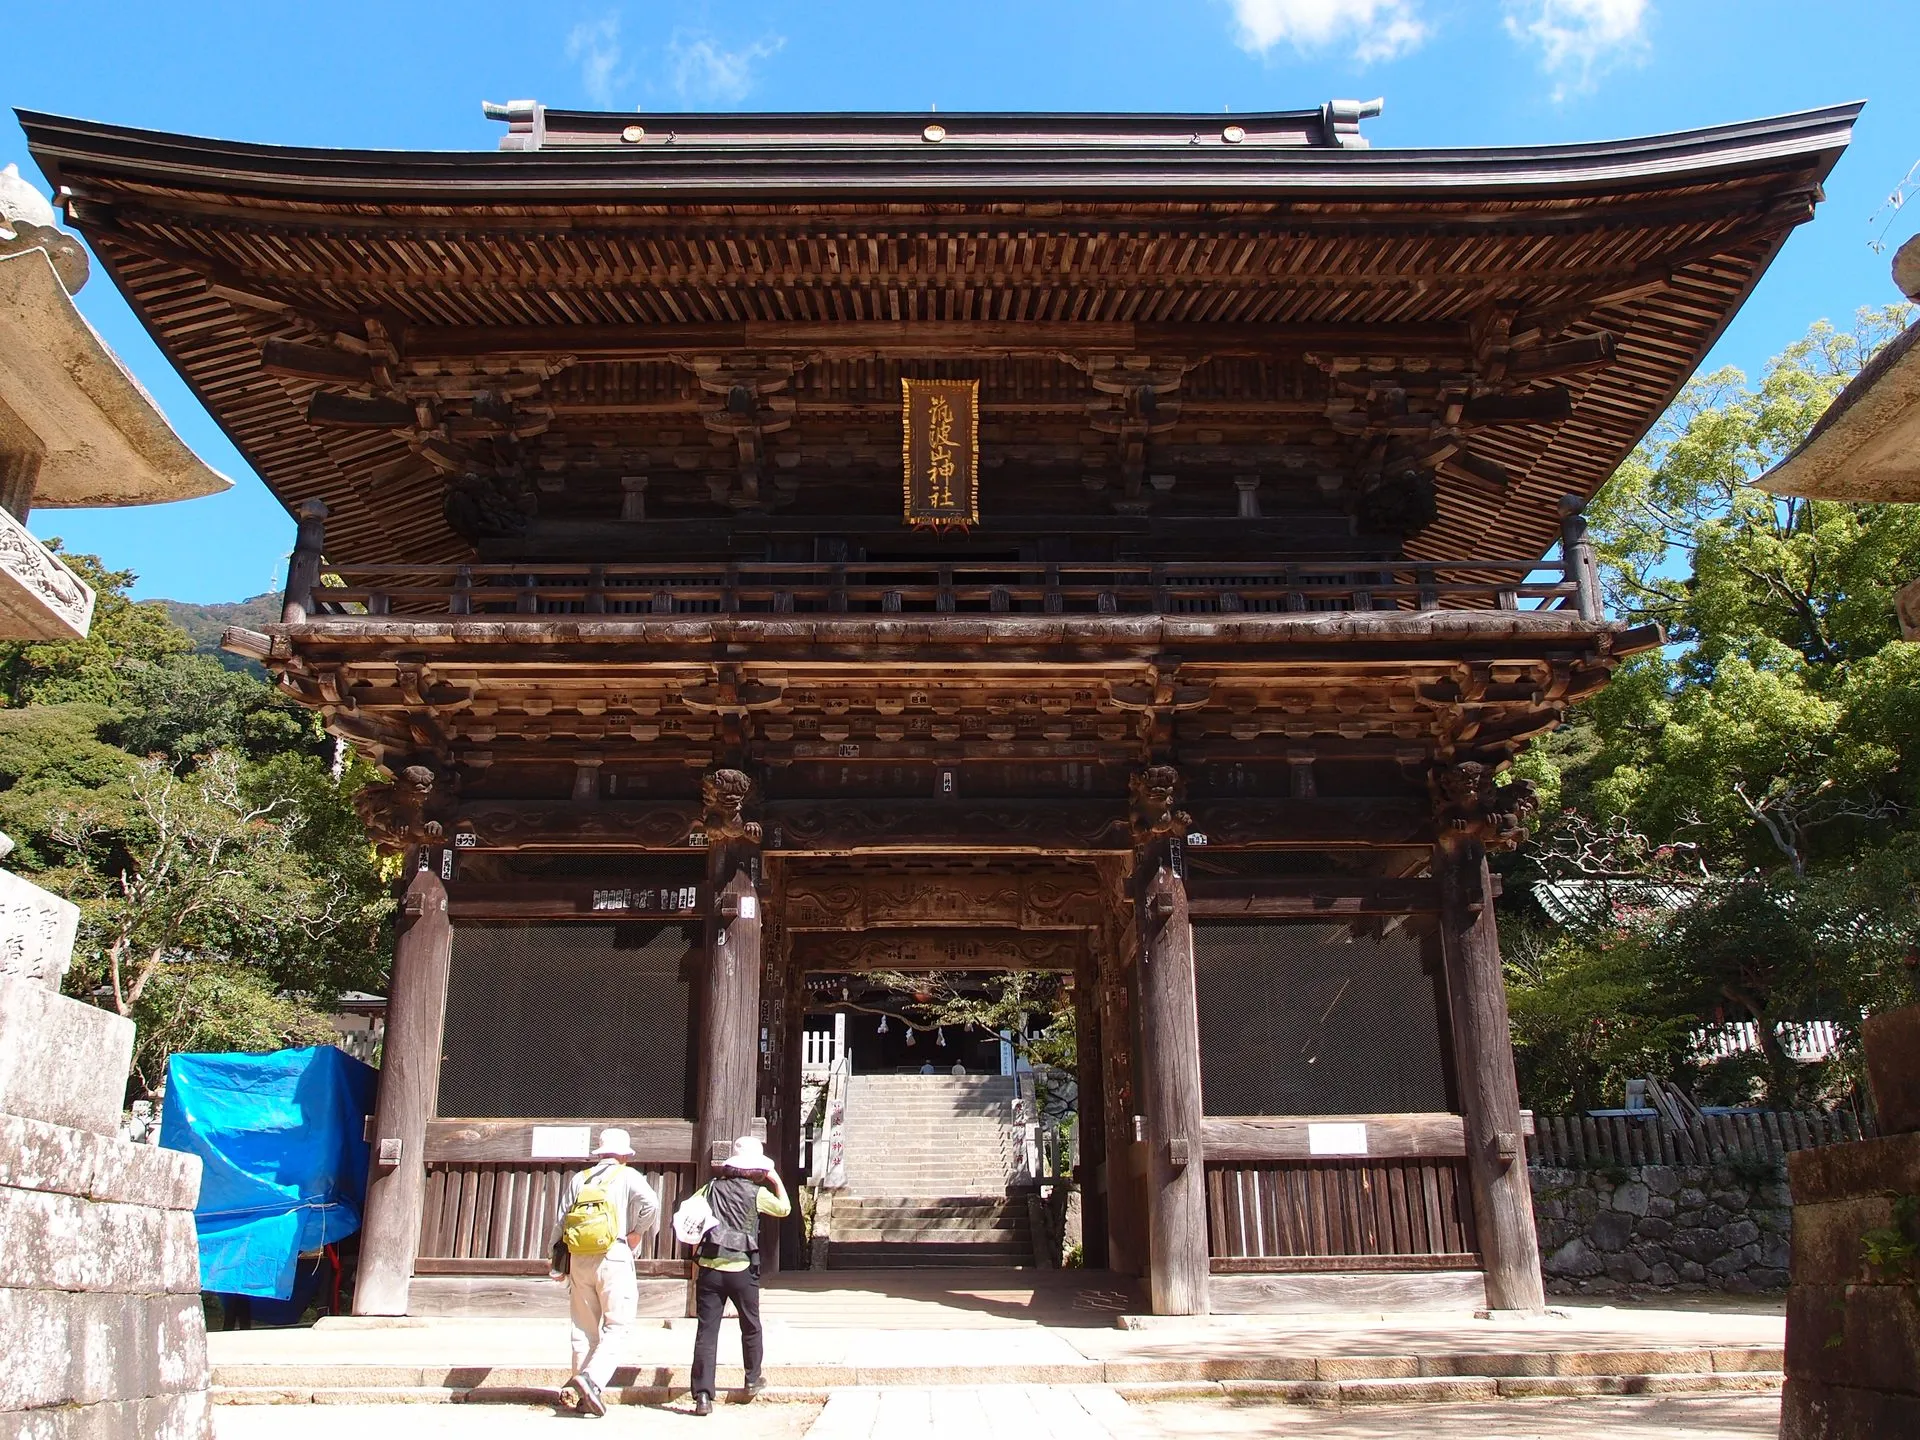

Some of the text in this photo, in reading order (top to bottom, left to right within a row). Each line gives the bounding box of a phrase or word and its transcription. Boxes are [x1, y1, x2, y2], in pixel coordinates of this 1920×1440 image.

[927, 395, 961, 508] 筑波山神社
